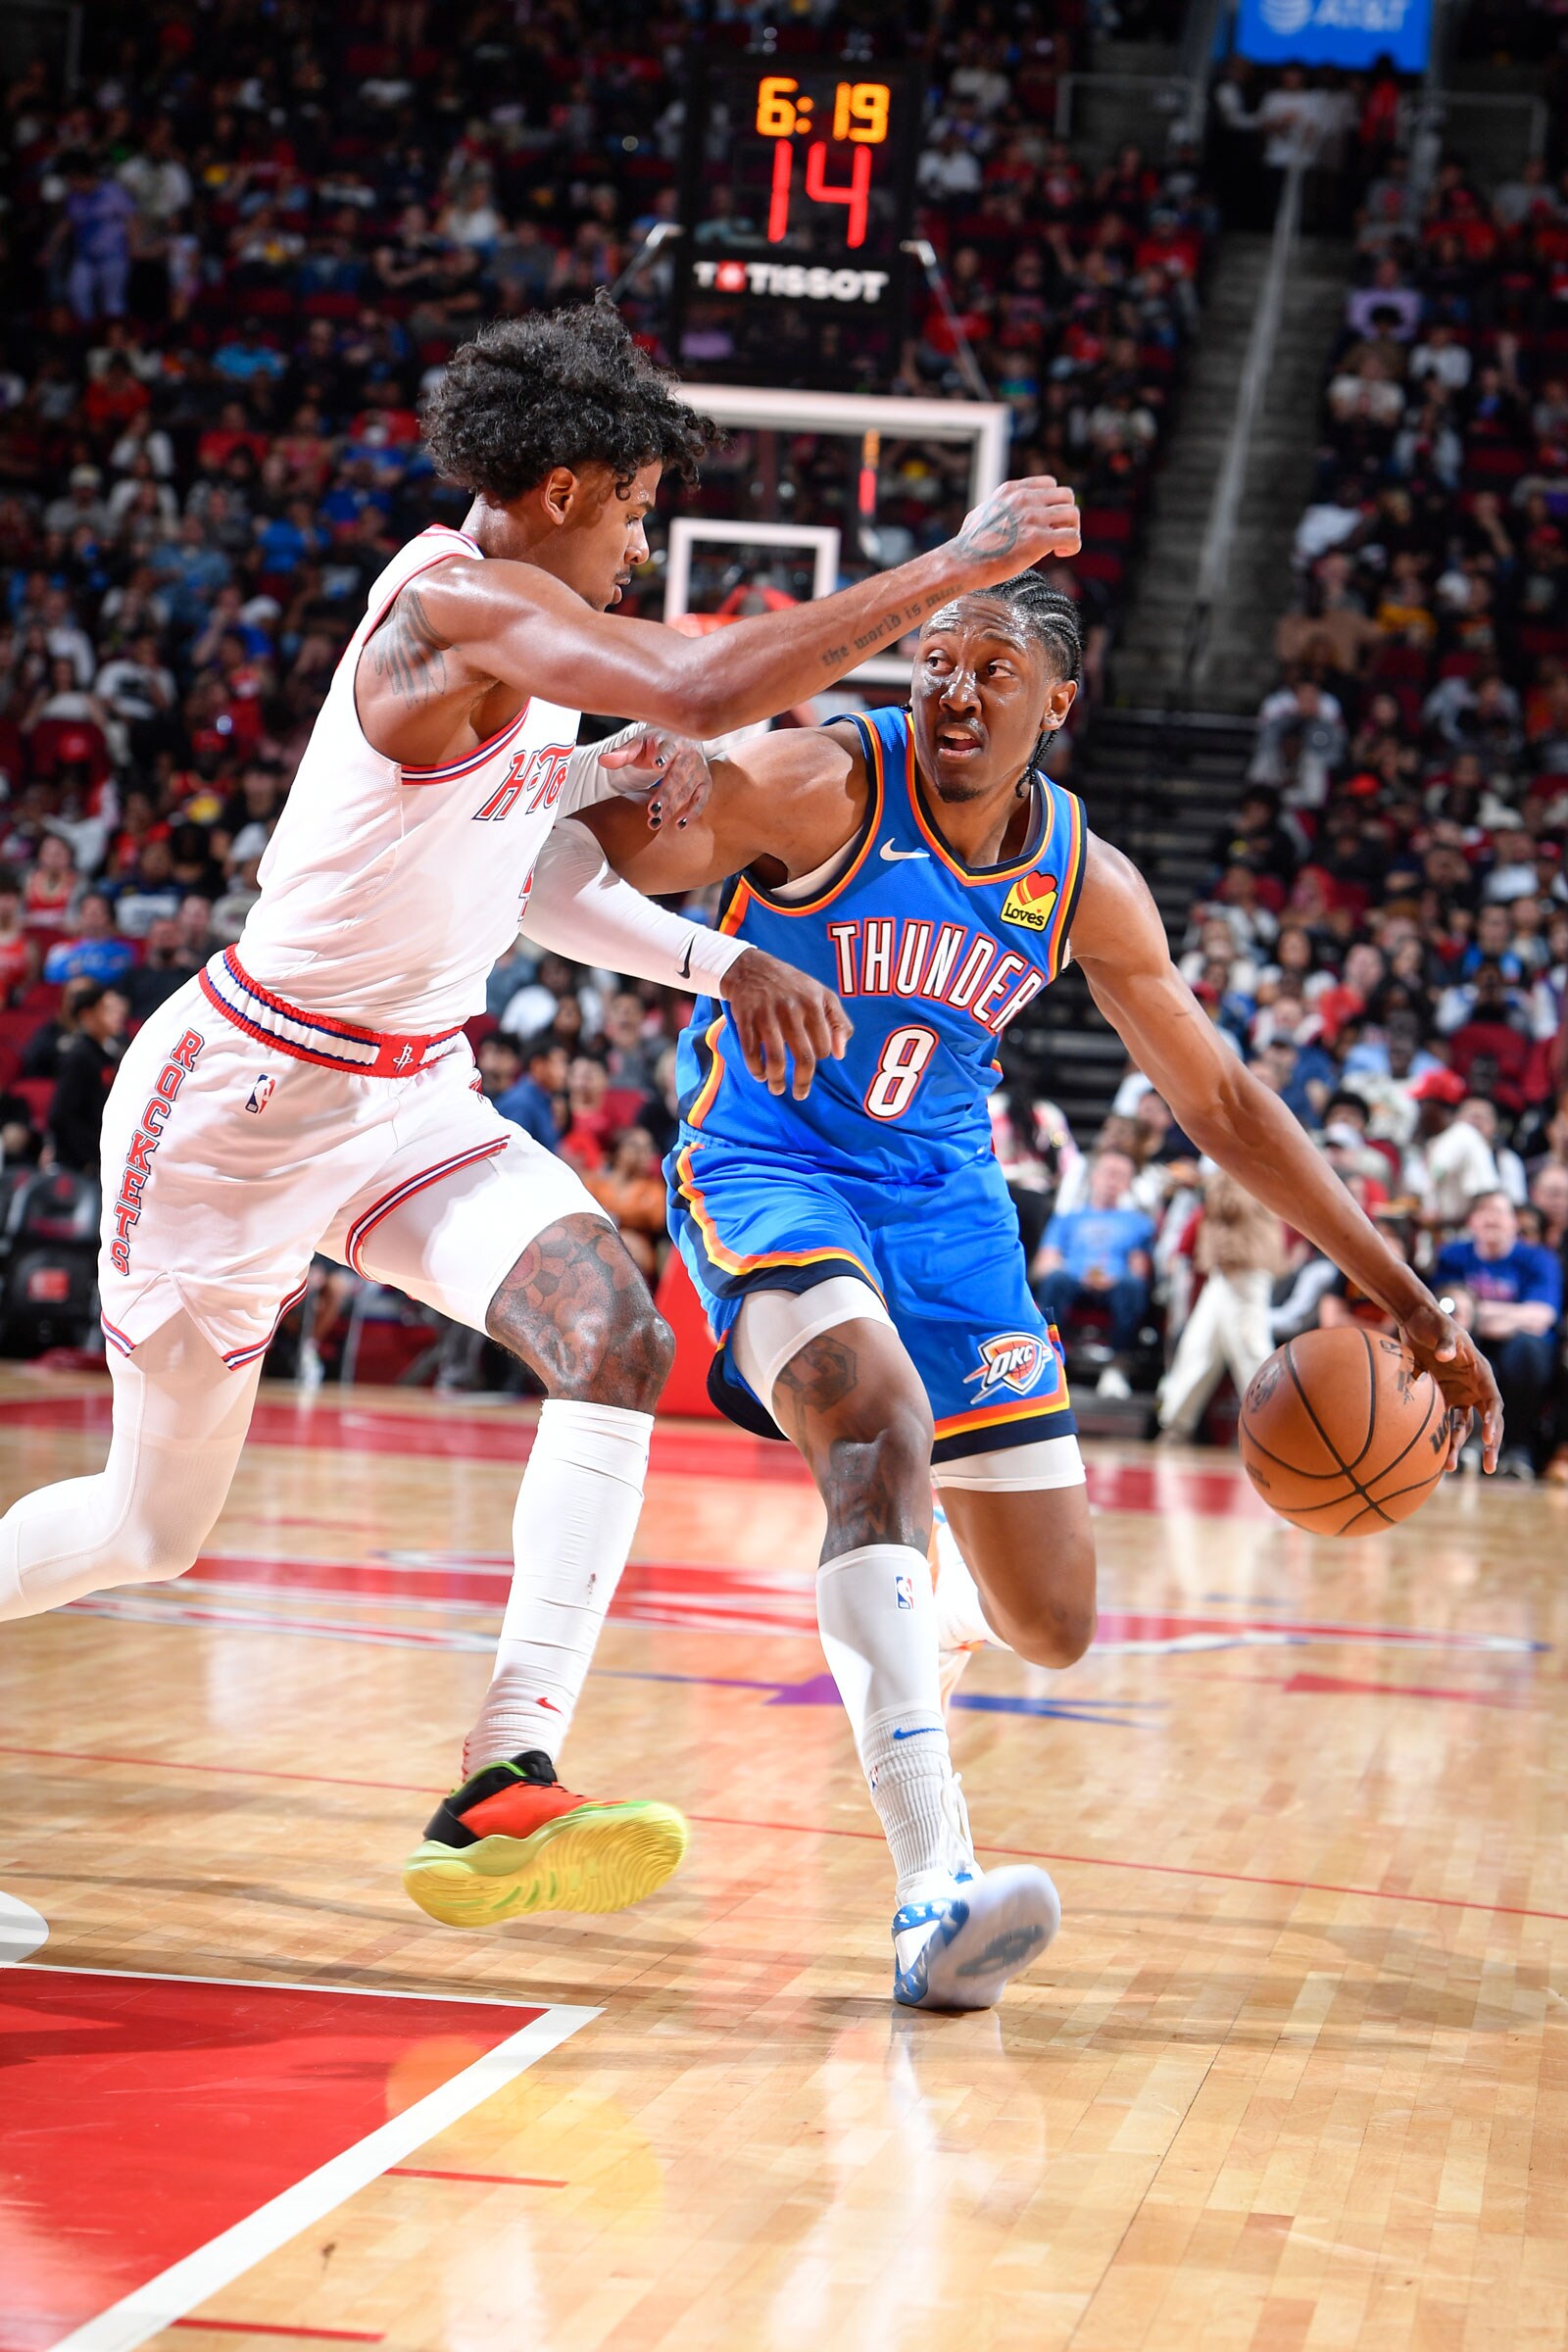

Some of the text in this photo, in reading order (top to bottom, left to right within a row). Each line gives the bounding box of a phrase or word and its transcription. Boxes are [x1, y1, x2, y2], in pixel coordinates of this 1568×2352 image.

[756, 76, 891, 143] 6:19
[768, 138, 872, 249] 14
[747, 262, 889, 303] TISSOT
[854, 612, 902, 650] world
[905, 603, 922, 620] is
[827, 916, 1045, 1036] THUNDER
[863, 1024, 940, 1121] 8
[110, 1027, 205, 1276] ROCKETS
[986, 1344, 1033, 1386] OKC
